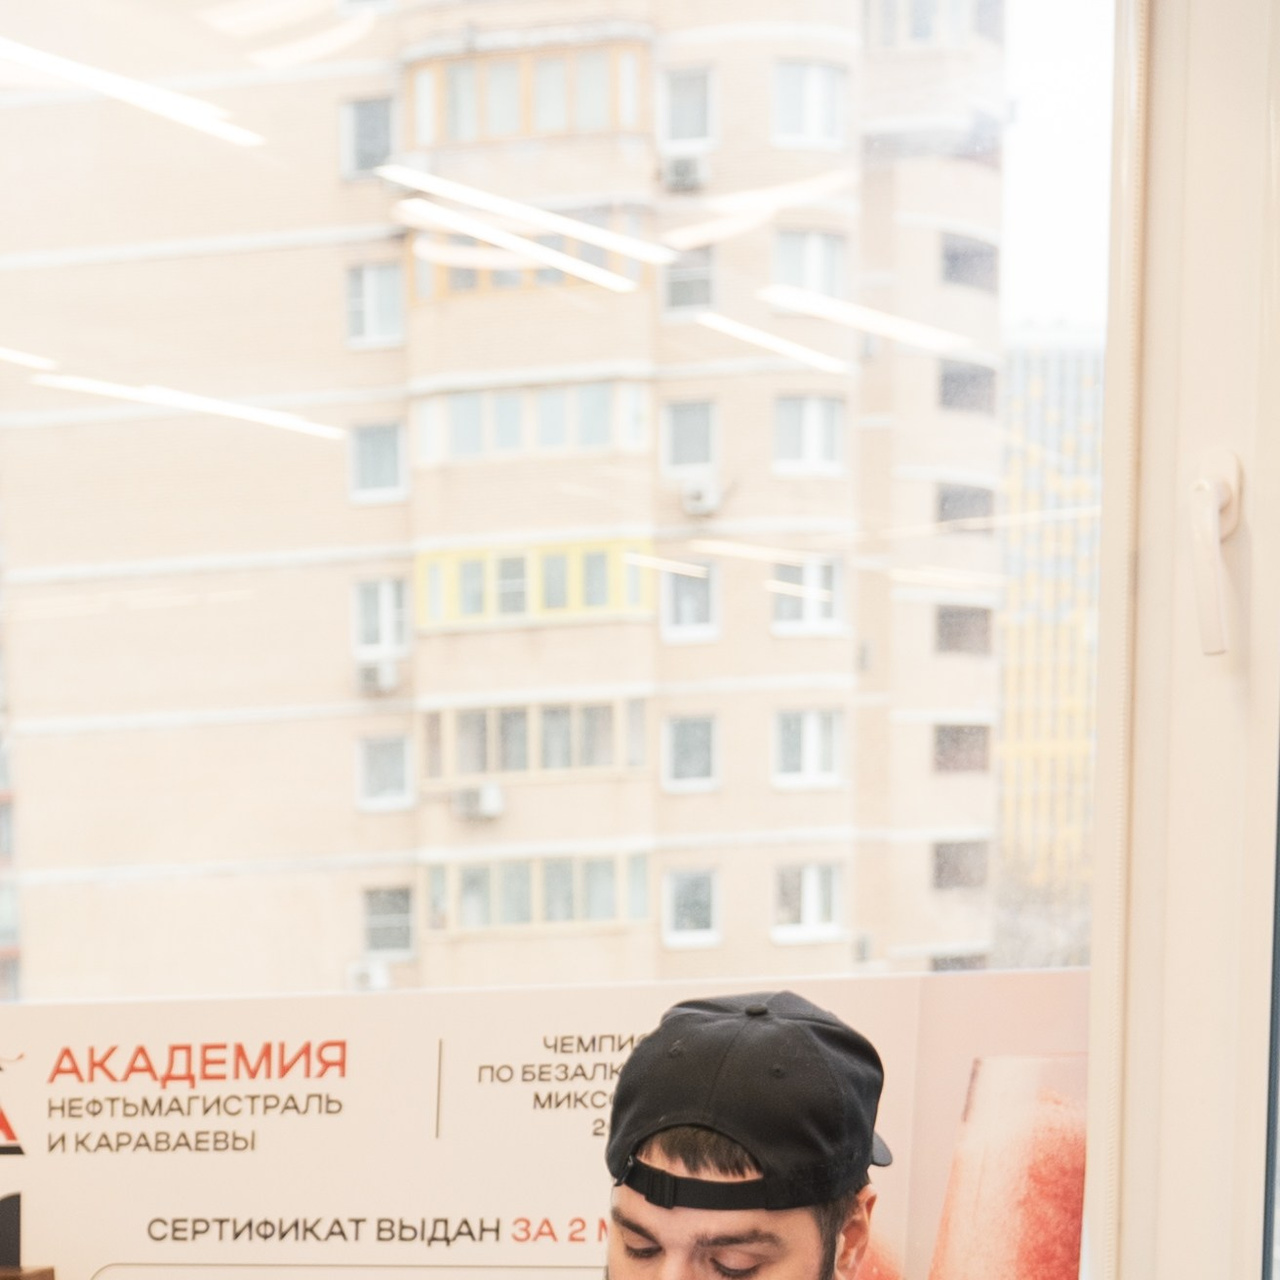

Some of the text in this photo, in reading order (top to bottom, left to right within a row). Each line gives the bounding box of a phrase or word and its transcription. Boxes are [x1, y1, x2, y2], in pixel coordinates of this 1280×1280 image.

[543, 1033, 648, 1054] ЧЕМПИ
[46, 1041, 348, 1089] АКАДЕМИЯ
[478, 1064, 514, 1083] ПО
[47, 1093, 343, 1118] НЕФТЬМАГИСТРАЛЬ
[532, 1090, 614, 1110] МИКС
[47, 1130, 256, 1153] И КАРАВАЕВЫ
[147, 1217, 367, 1243] СЕРТИФИКАТ
[376, 1217, 501, 1248] ВЫДАН
[511, 1217, 558, 1243] ЗА
[567, 1217, 587, 1242] 2
